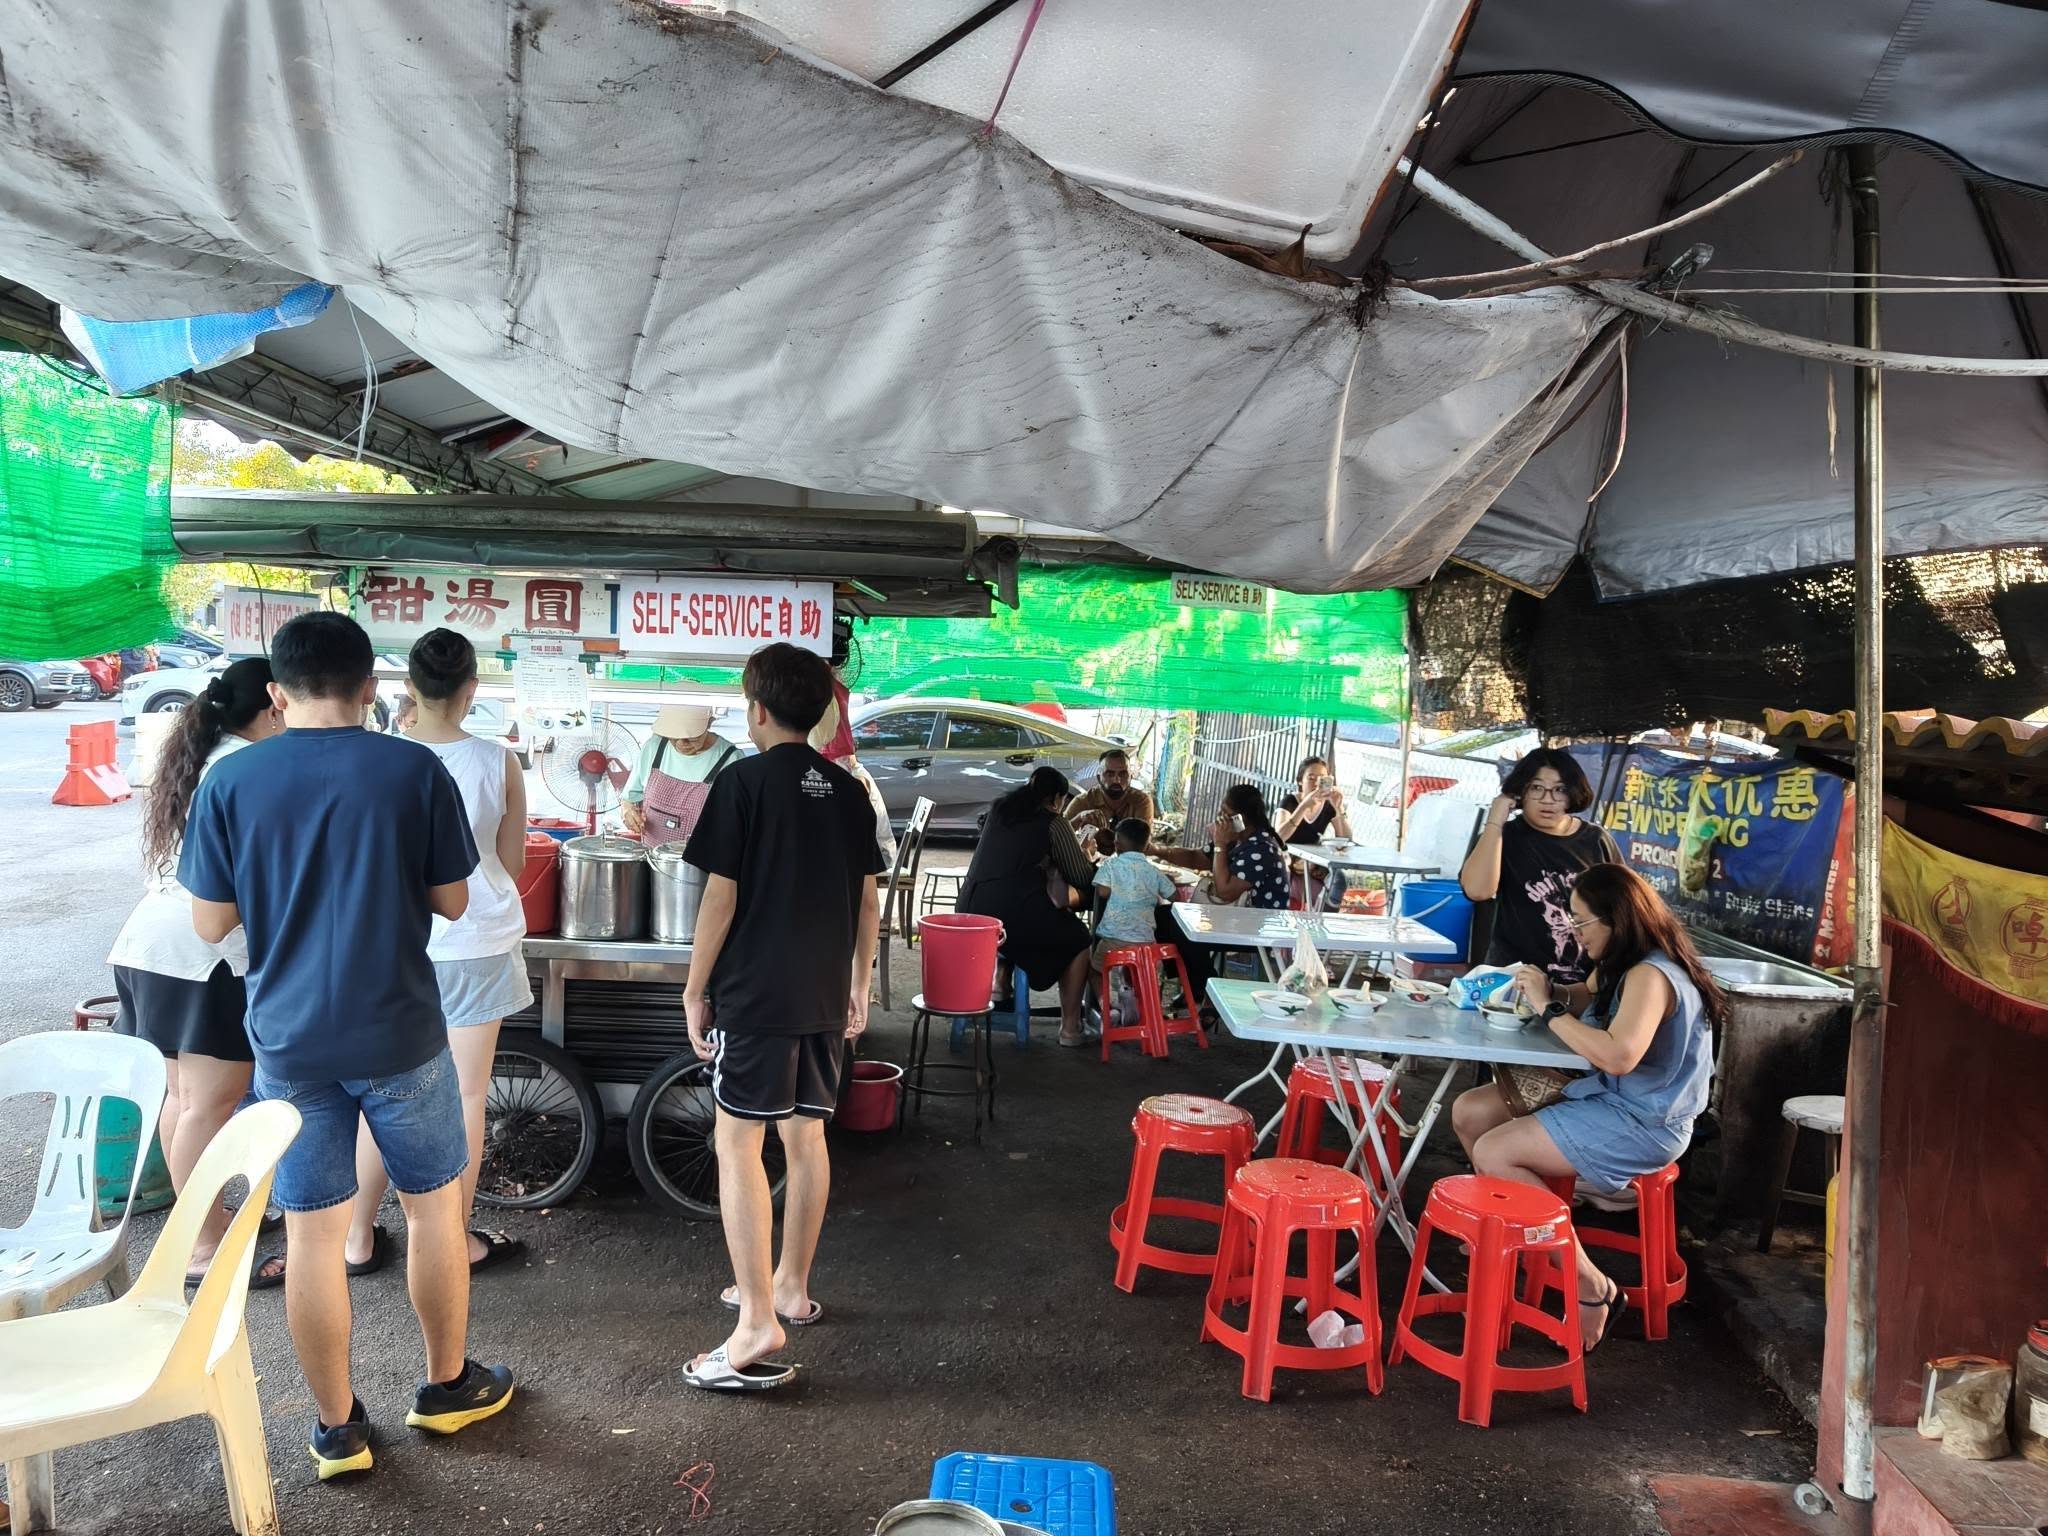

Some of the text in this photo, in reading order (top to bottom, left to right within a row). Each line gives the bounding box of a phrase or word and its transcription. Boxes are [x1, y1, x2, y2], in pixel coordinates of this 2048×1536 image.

[364, 575, 583, 634] 甜湯圓
[632, 590, 822, 640] SELF-SERVICE 自助
[1175, 579, 1241, 604] SELF-SERVICE
